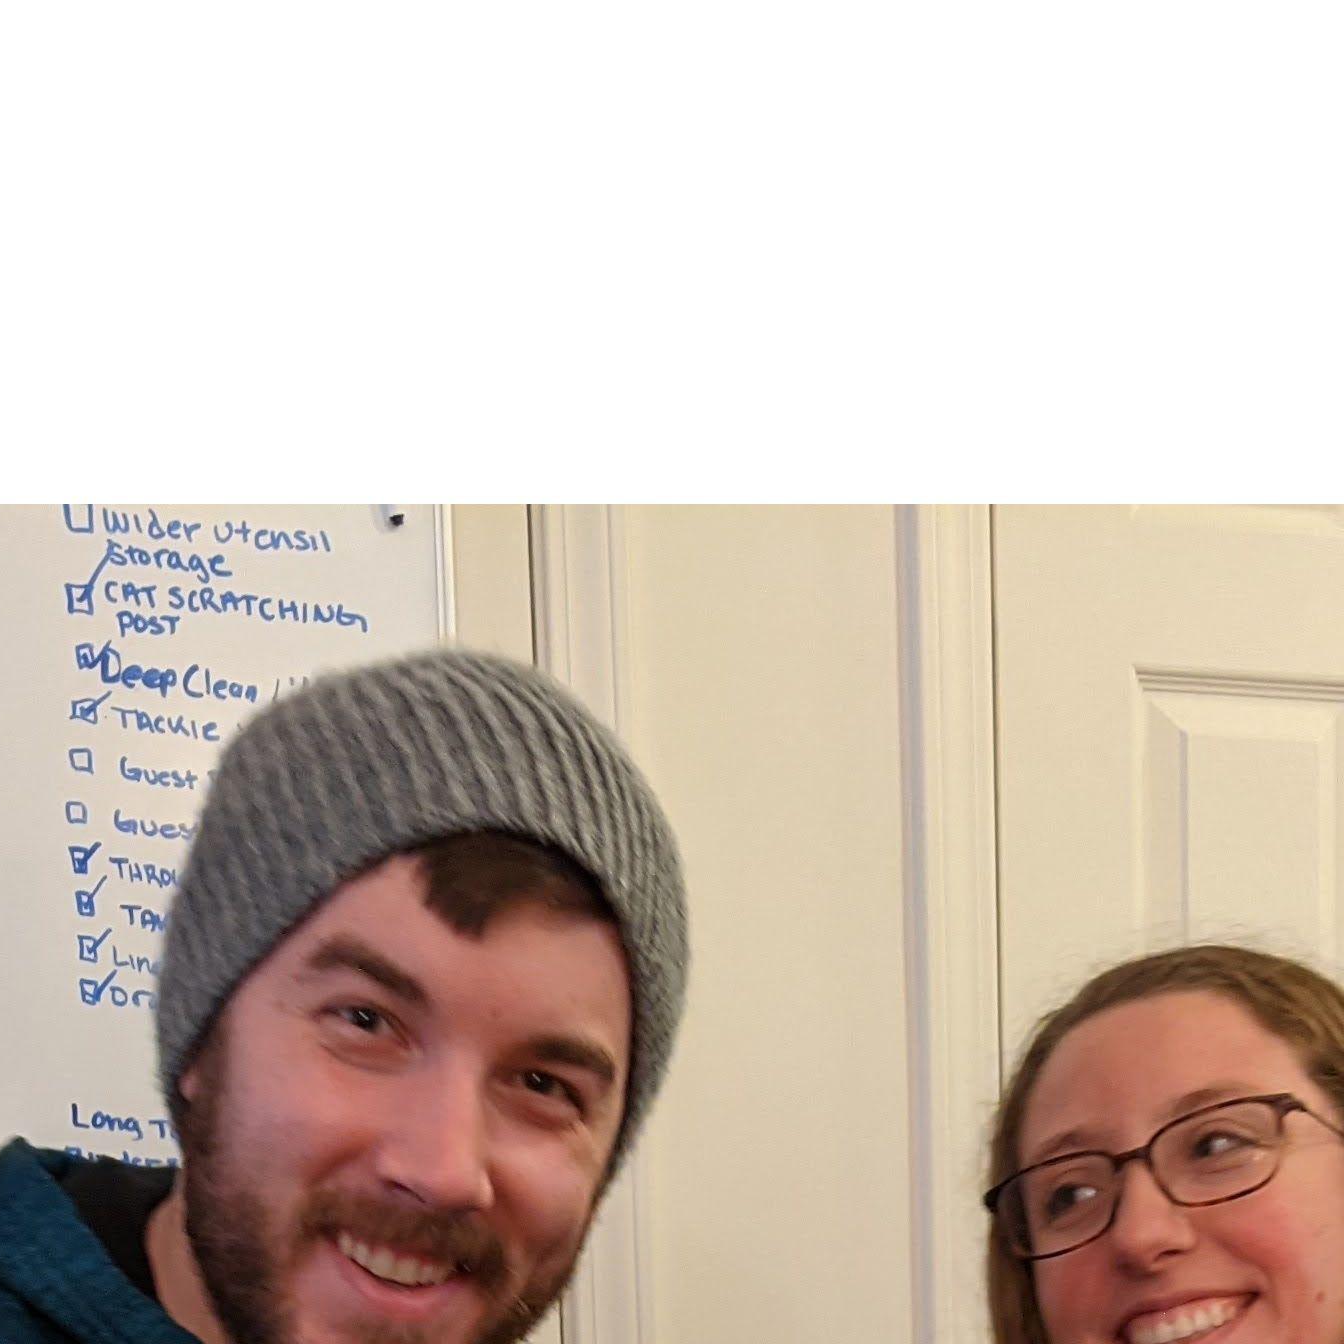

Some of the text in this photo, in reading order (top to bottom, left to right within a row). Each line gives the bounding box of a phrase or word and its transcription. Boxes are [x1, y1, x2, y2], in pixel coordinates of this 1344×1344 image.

[104, 580, 368, 633] CAT SCRATCHING
[116, 615, 181, 637] POST
[99, 644, 178, 698] Deep
[182, 663, 259, 704] Clean
[119, 756, 199, 789] Guest
[71, 1102, 144, 1142] Long
